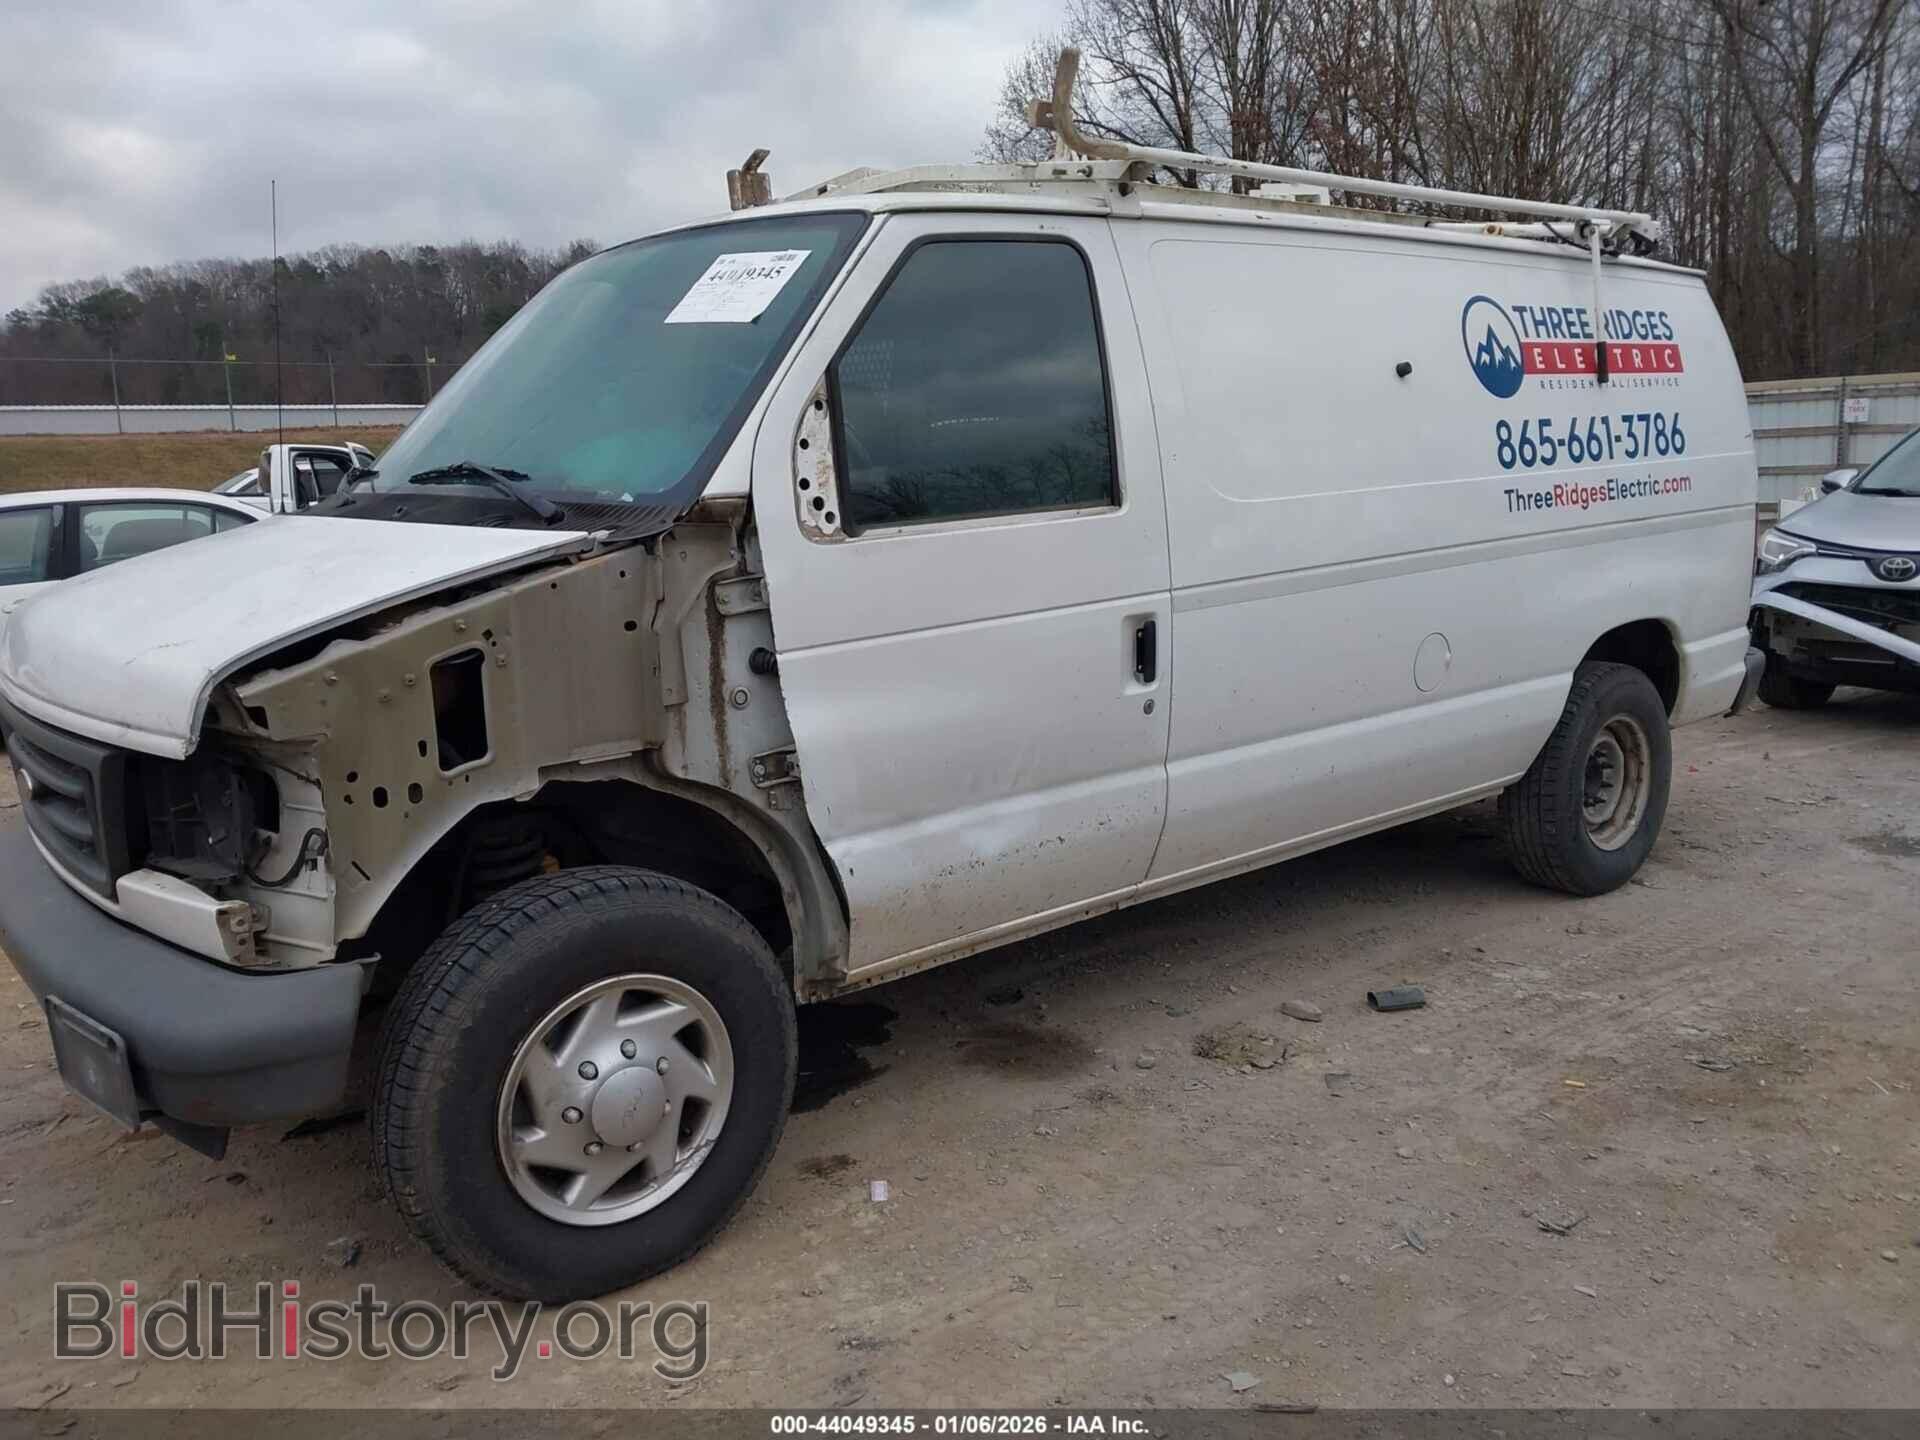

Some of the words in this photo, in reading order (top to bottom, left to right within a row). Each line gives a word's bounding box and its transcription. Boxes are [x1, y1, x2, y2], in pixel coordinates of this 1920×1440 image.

[1511, 304, 1594, 340] THREE
[1533, 348, 1676, 369] ELETRIC
[1540, 377, 1679, 389] RESIDENAL/SERVICE
[1496, 411, 1686, 470] 865-661-3786
[1504, 473, 1692, 513] ThreeRidgesElectric.com
